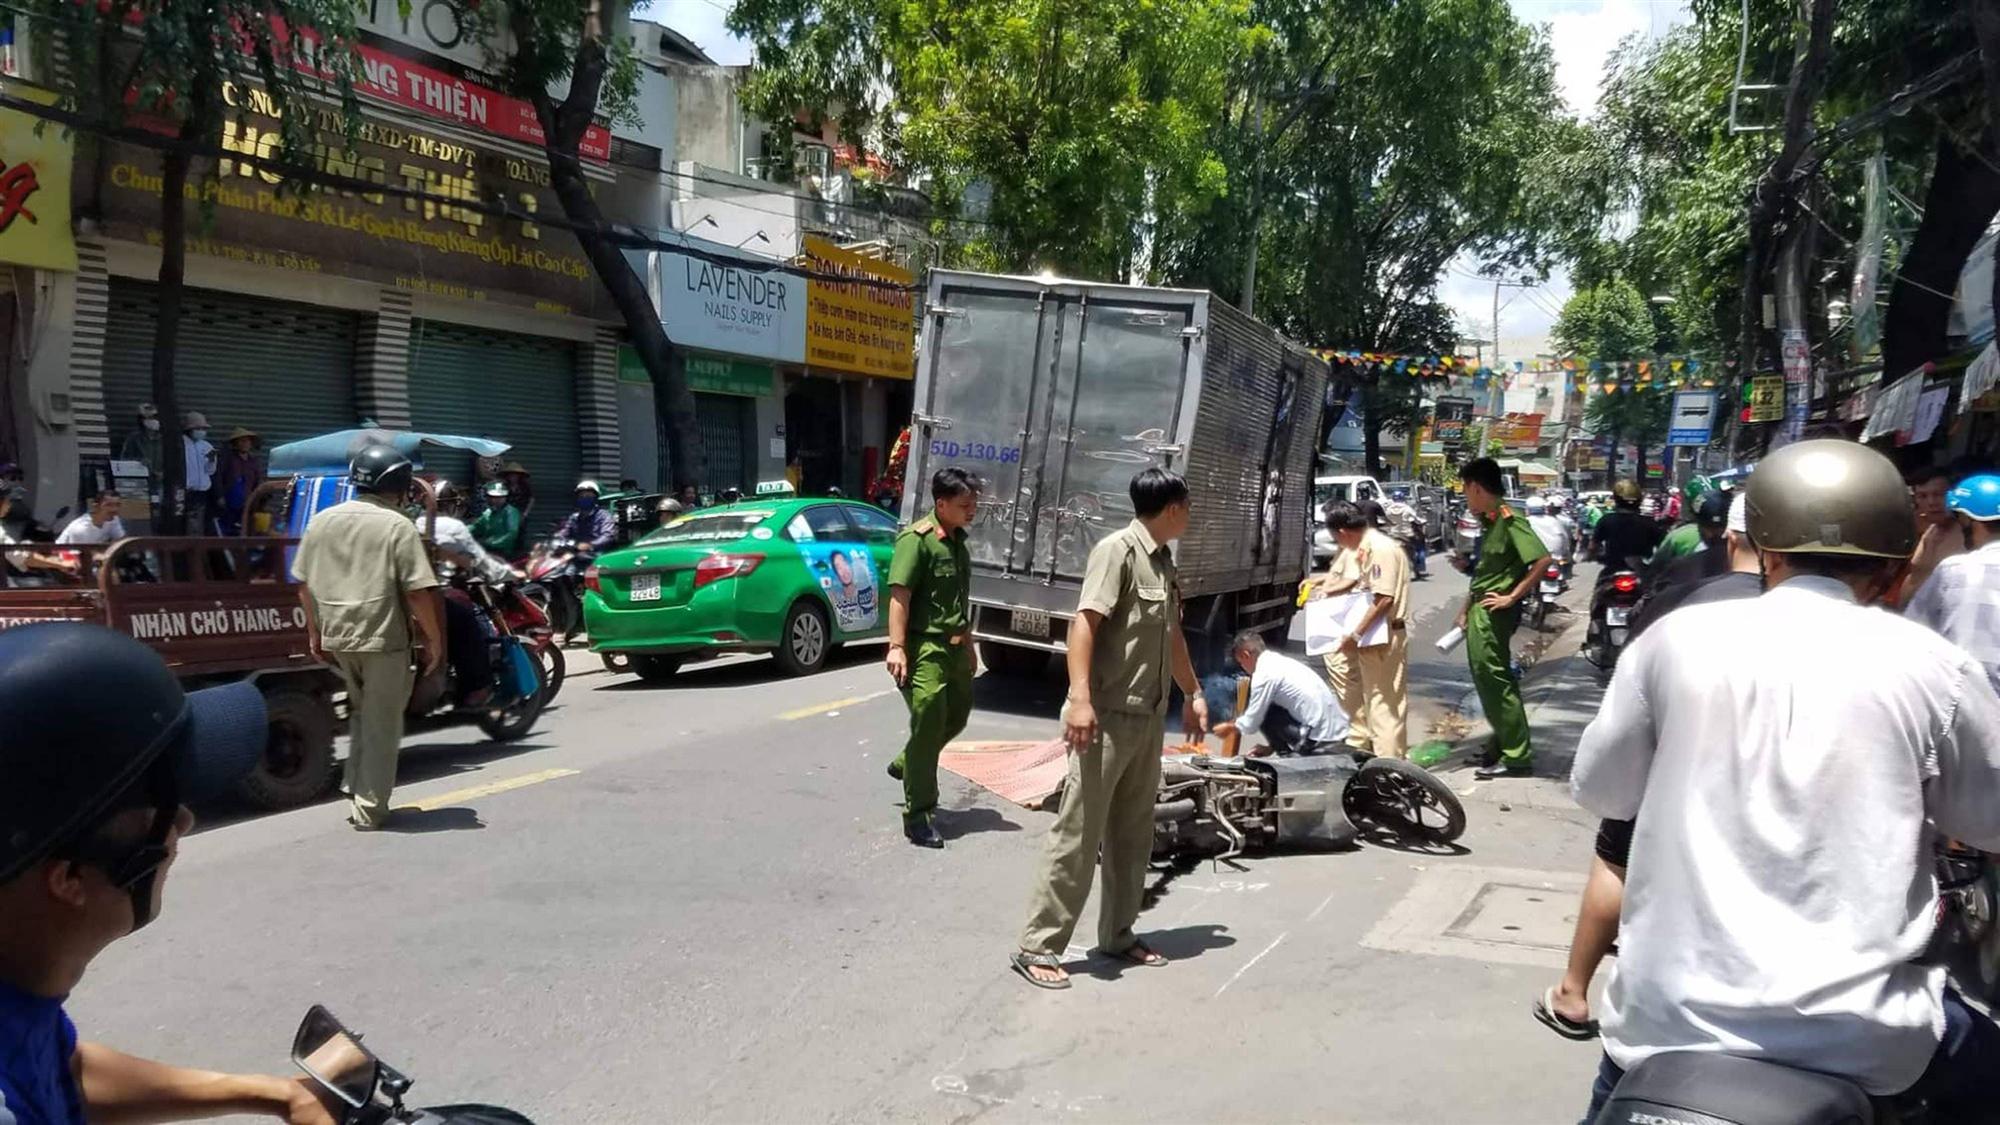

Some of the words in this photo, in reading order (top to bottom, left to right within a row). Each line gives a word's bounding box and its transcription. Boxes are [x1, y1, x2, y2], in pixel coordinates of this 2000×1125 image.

[405, 70, 486, 124] THIỆN
[686, 257, 787, 312] LAVENDER
[704, 301, 737, 322] NAILS
[741, 308, 772, 327] SUPPLY
[930, 440, 1020, 463] 51D-130.66
[131, 607, 187, 643] NHẬN
[190, 600, 229, 635] CHỞ
